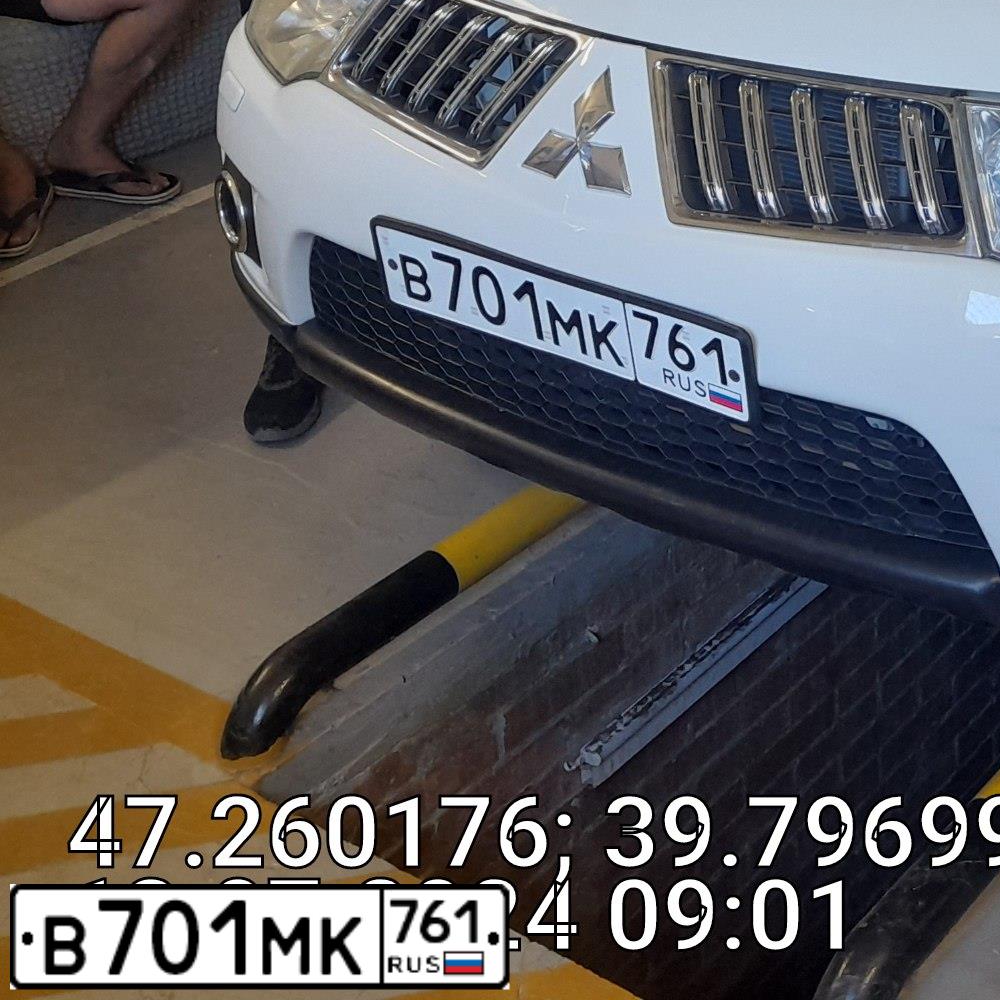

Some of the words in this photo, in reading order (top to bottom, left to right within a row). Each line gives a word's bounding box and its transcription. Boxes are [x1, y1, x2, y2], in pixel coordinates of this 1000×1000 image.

[398, 250, 626, 367] В701МК
[632, 310, 728, 386] 761
[662, 367, 707, 398] RUS
